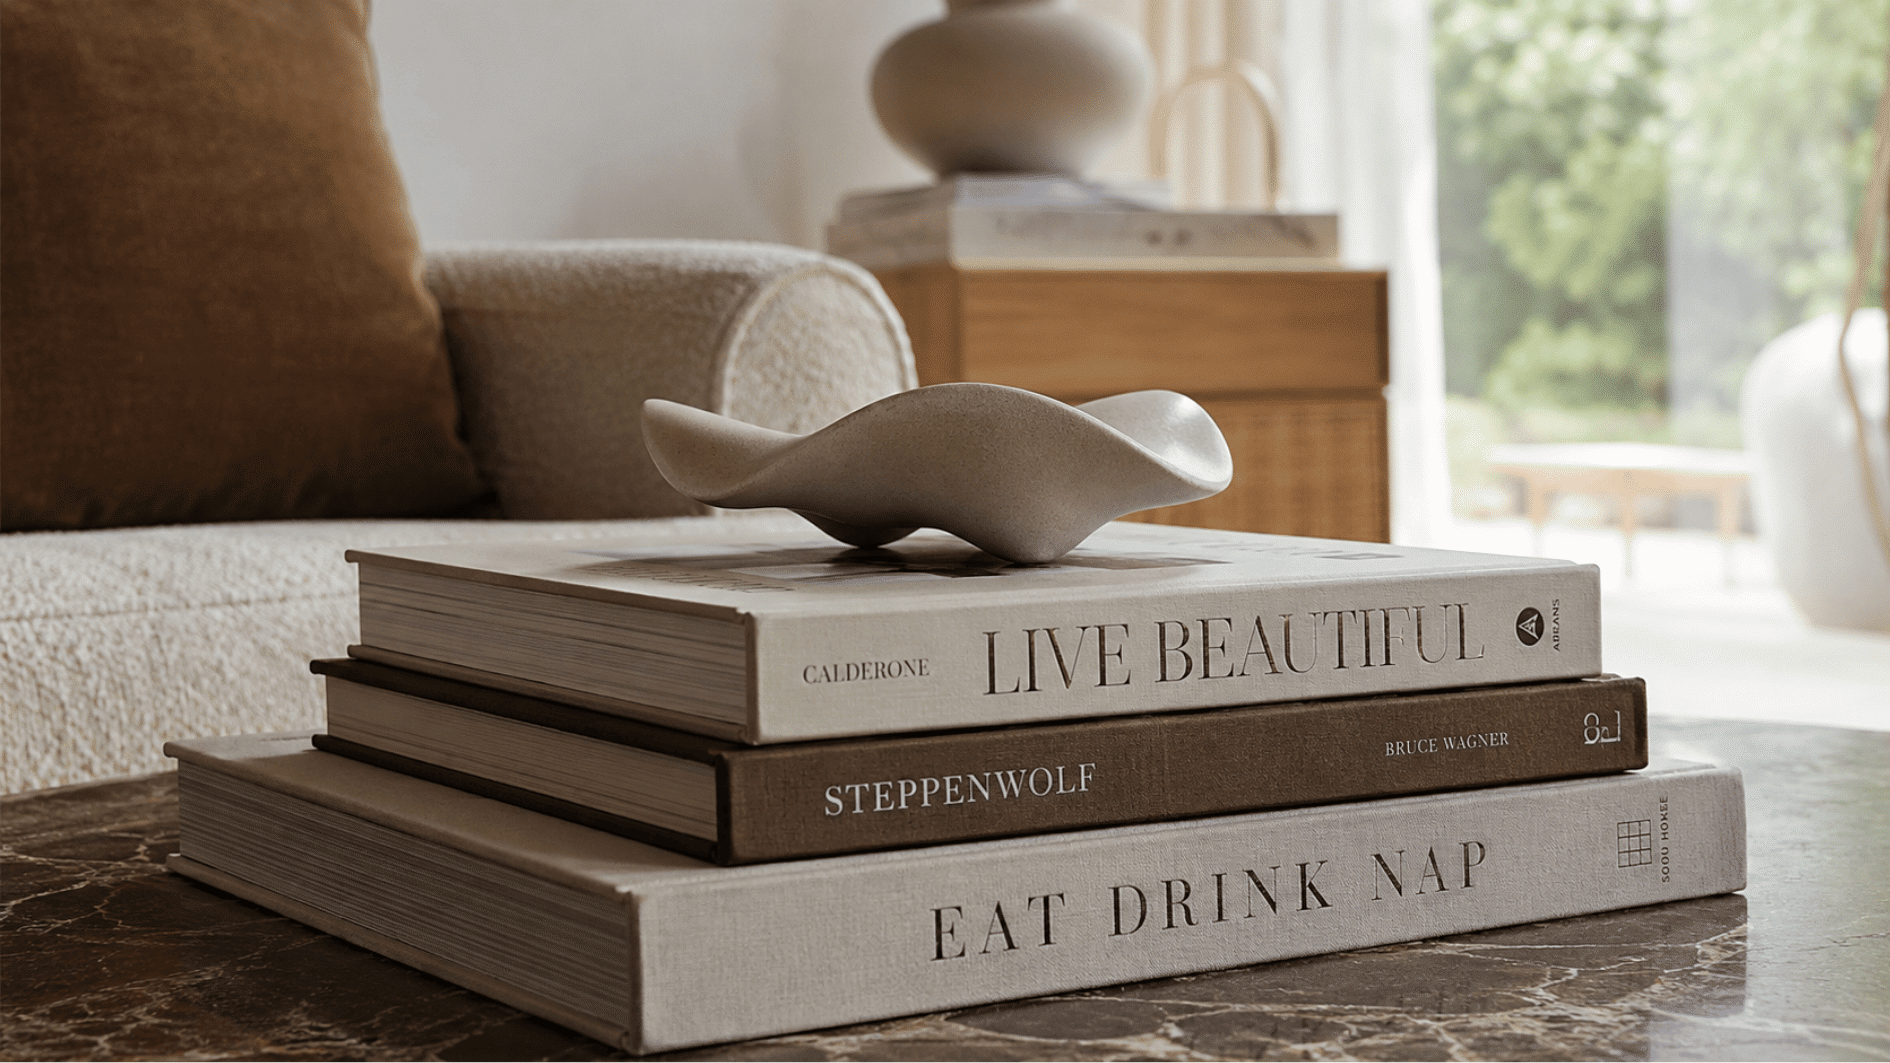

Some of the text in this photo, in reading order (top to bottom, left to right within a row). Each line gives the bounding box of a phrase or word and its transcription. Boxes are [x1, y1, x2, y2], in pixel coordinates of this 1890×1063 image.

[803, 658, 930, 685] CALDERONE
[982, 603, 1485, 696] LIVE BEAUTIFUL
[1385, 732, 1510, 757] BRUCE WAGNER
[824, 763, 1097, 816] STEPPENWOLF
[929, 840, 1487, 962] EAT DRINK NAP
